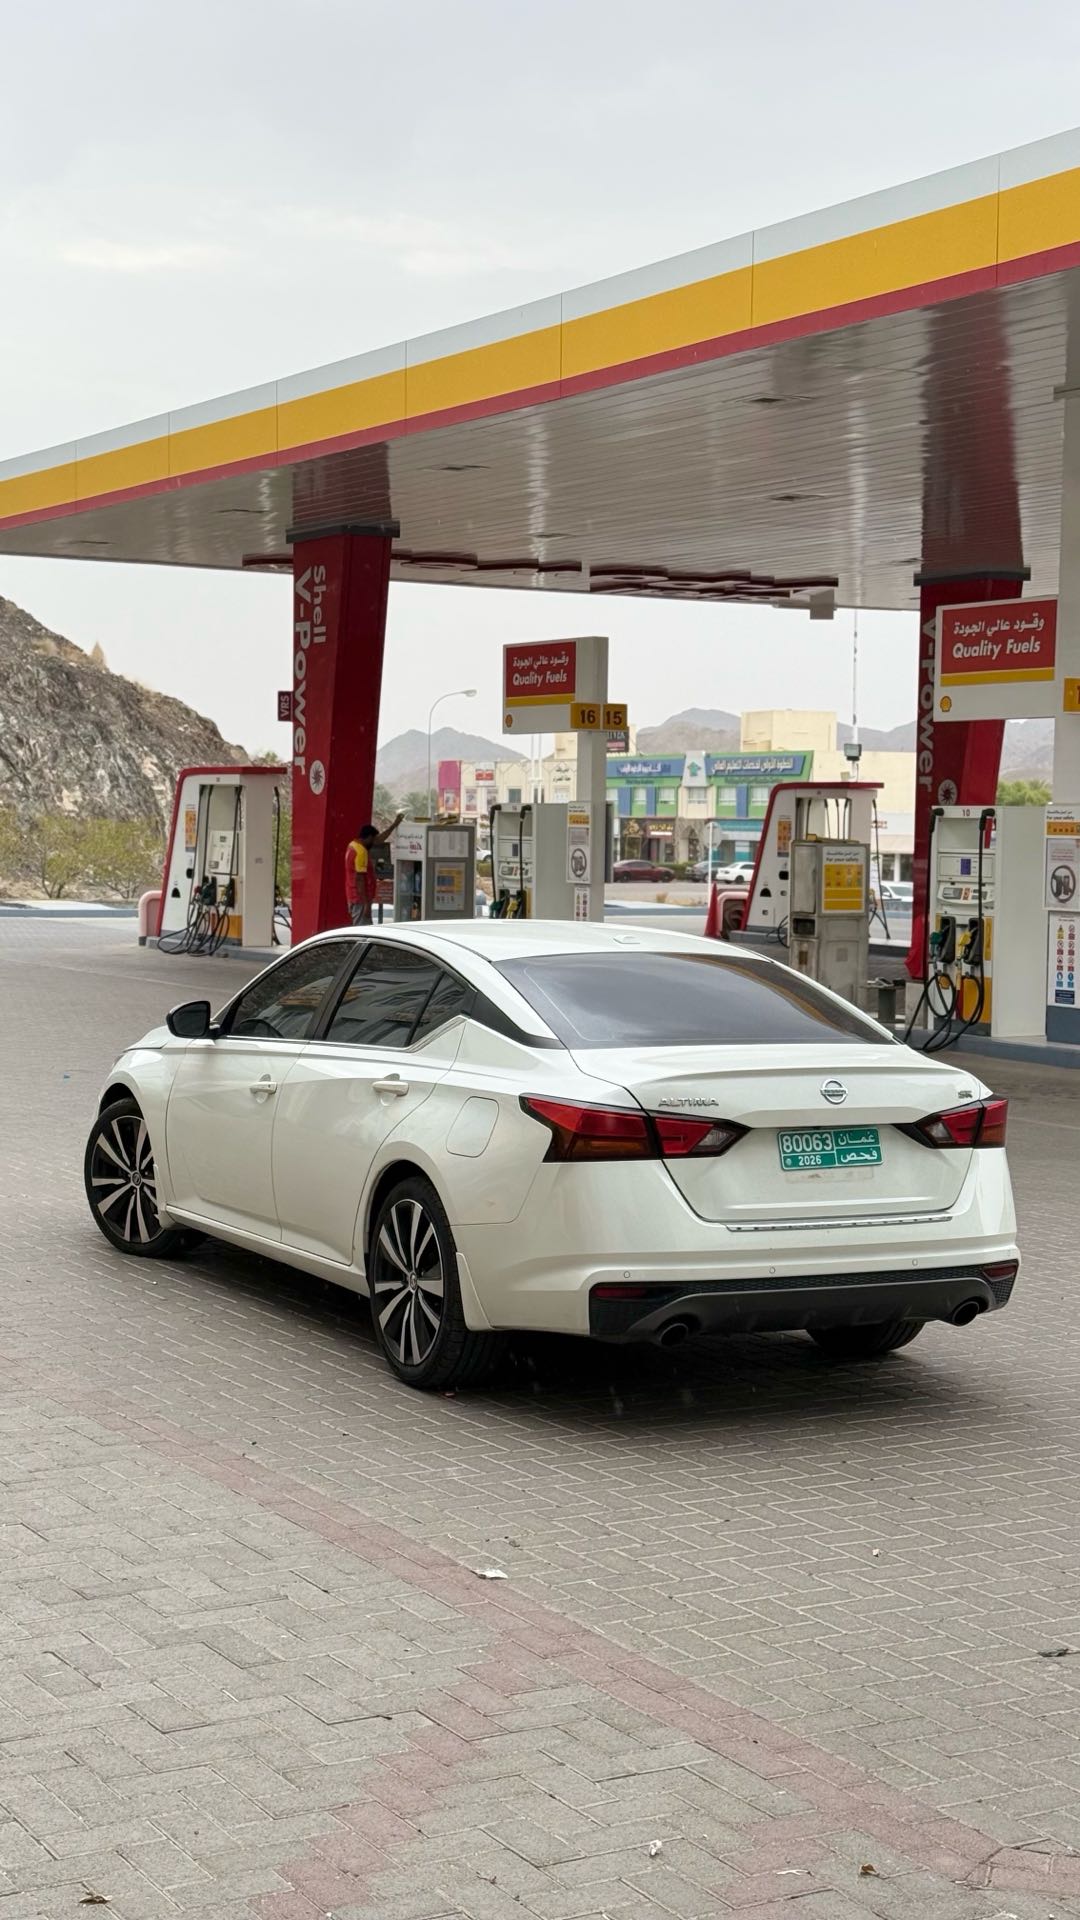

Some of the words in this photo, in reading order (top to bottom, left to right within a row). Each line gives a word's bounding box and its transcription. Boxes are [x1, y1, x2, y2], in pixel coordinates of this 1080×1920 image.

[313, 565, 326, 644] Shell
[953, 621, 985, 637] الجودة
[987, 619, 1010, 637] عالي
[1013, 613, 1045, 632] وقود
[952, 640, 1002, 660] Quality
[1006, 635, 1041, 654] Fuels
[513, 656, 533, 669] الجودة
[533, 655, 549, 670] عالي
[550, 651, 569, 666] وقود
[294, 566, 312, 776] V-Power
[512, 671, 544, 687] Quality
[546, 669, 567, 684] Fuels
[280, 694, 290, 718] VRS
[580, 709, 596, 724] 16
[606, 710, 622, 725] 15
[962, 809, 971, 817] 10
[658, 1097, 719, 1107] ALTIMA
[782, 1133, 833, 1153] 80063
[798, 1156, 822, 1166] 2026
[841, 1148, 878, 1163] فحص
